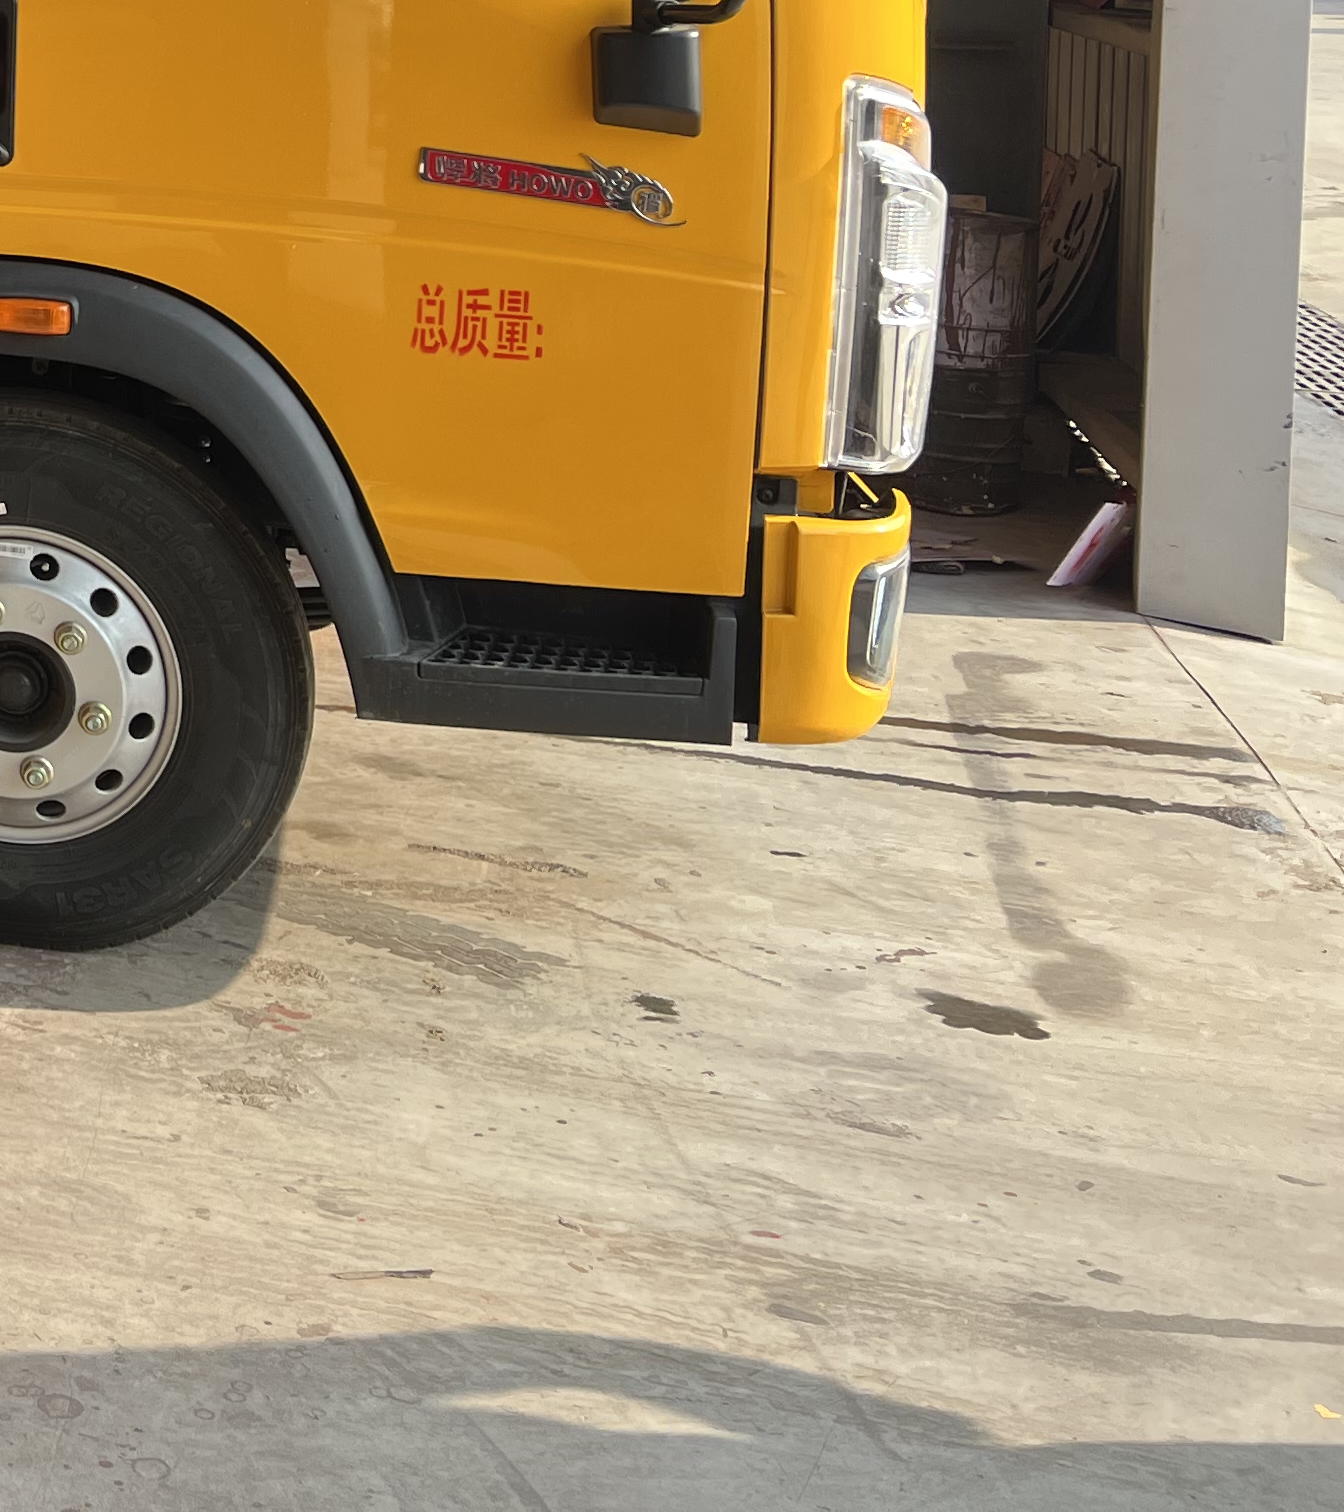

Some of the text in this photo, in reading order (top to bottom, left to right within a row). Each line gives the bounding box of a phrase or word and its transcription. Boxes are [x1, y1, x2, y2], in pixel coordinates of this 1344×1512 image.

[508, 169, 593, 200] HOWO
[411, 284, 543, 360] 总质量:
[95, 484, 243, 632] REGIONAL
[56, 842, 195, 918] SAR31
